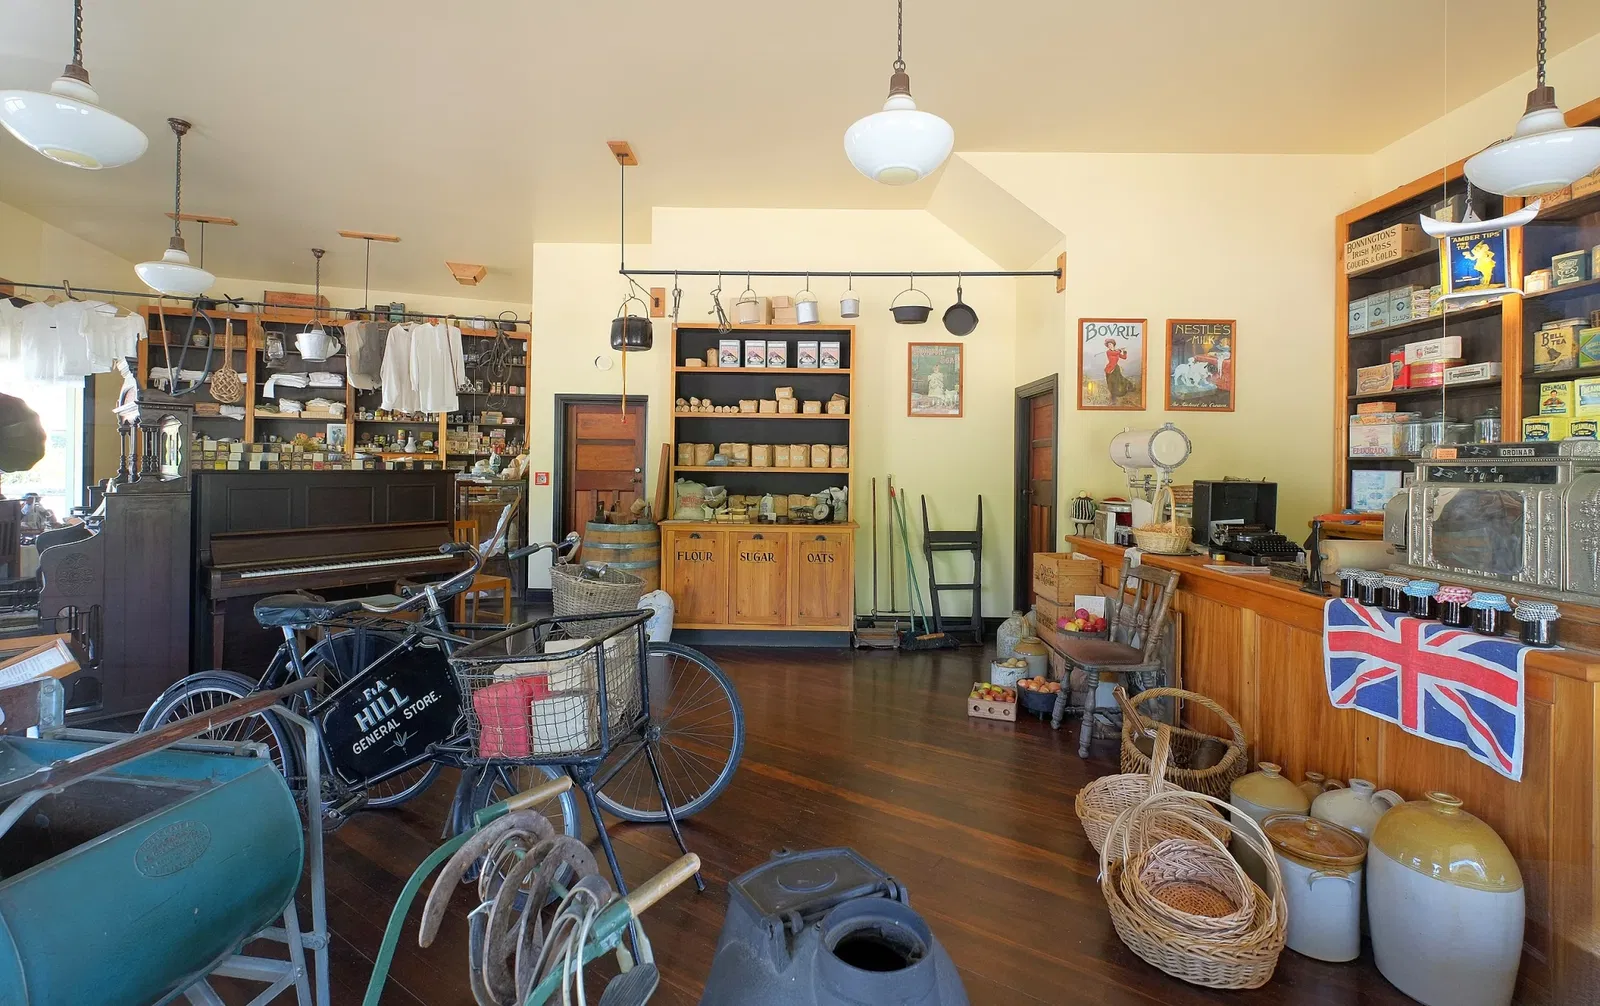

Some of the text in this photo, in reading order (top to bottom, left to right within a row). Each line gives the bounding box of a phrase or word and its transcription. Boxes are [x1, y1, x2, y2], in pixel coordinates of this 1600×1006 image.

[1346, 228, 1397, 254] BONNINGTONS
[1352, 240, 1392, 260] IRISH MOSS
[1085, 323, 1140, 343] BOVRIL
[1191, 335, 1216, 345] MILK
[1541, 332, 1564, 347] BELL
[1551, 338, 1567, 346] TEA
[677, 551, 714, 562] FLOUR
[740, 552, 777, 563] SUGAR
[807, 553, 834, 563] OATS
[354, 687, 410, 733] HILL
[352, 690, 442, 755] GENERAL STORE.
